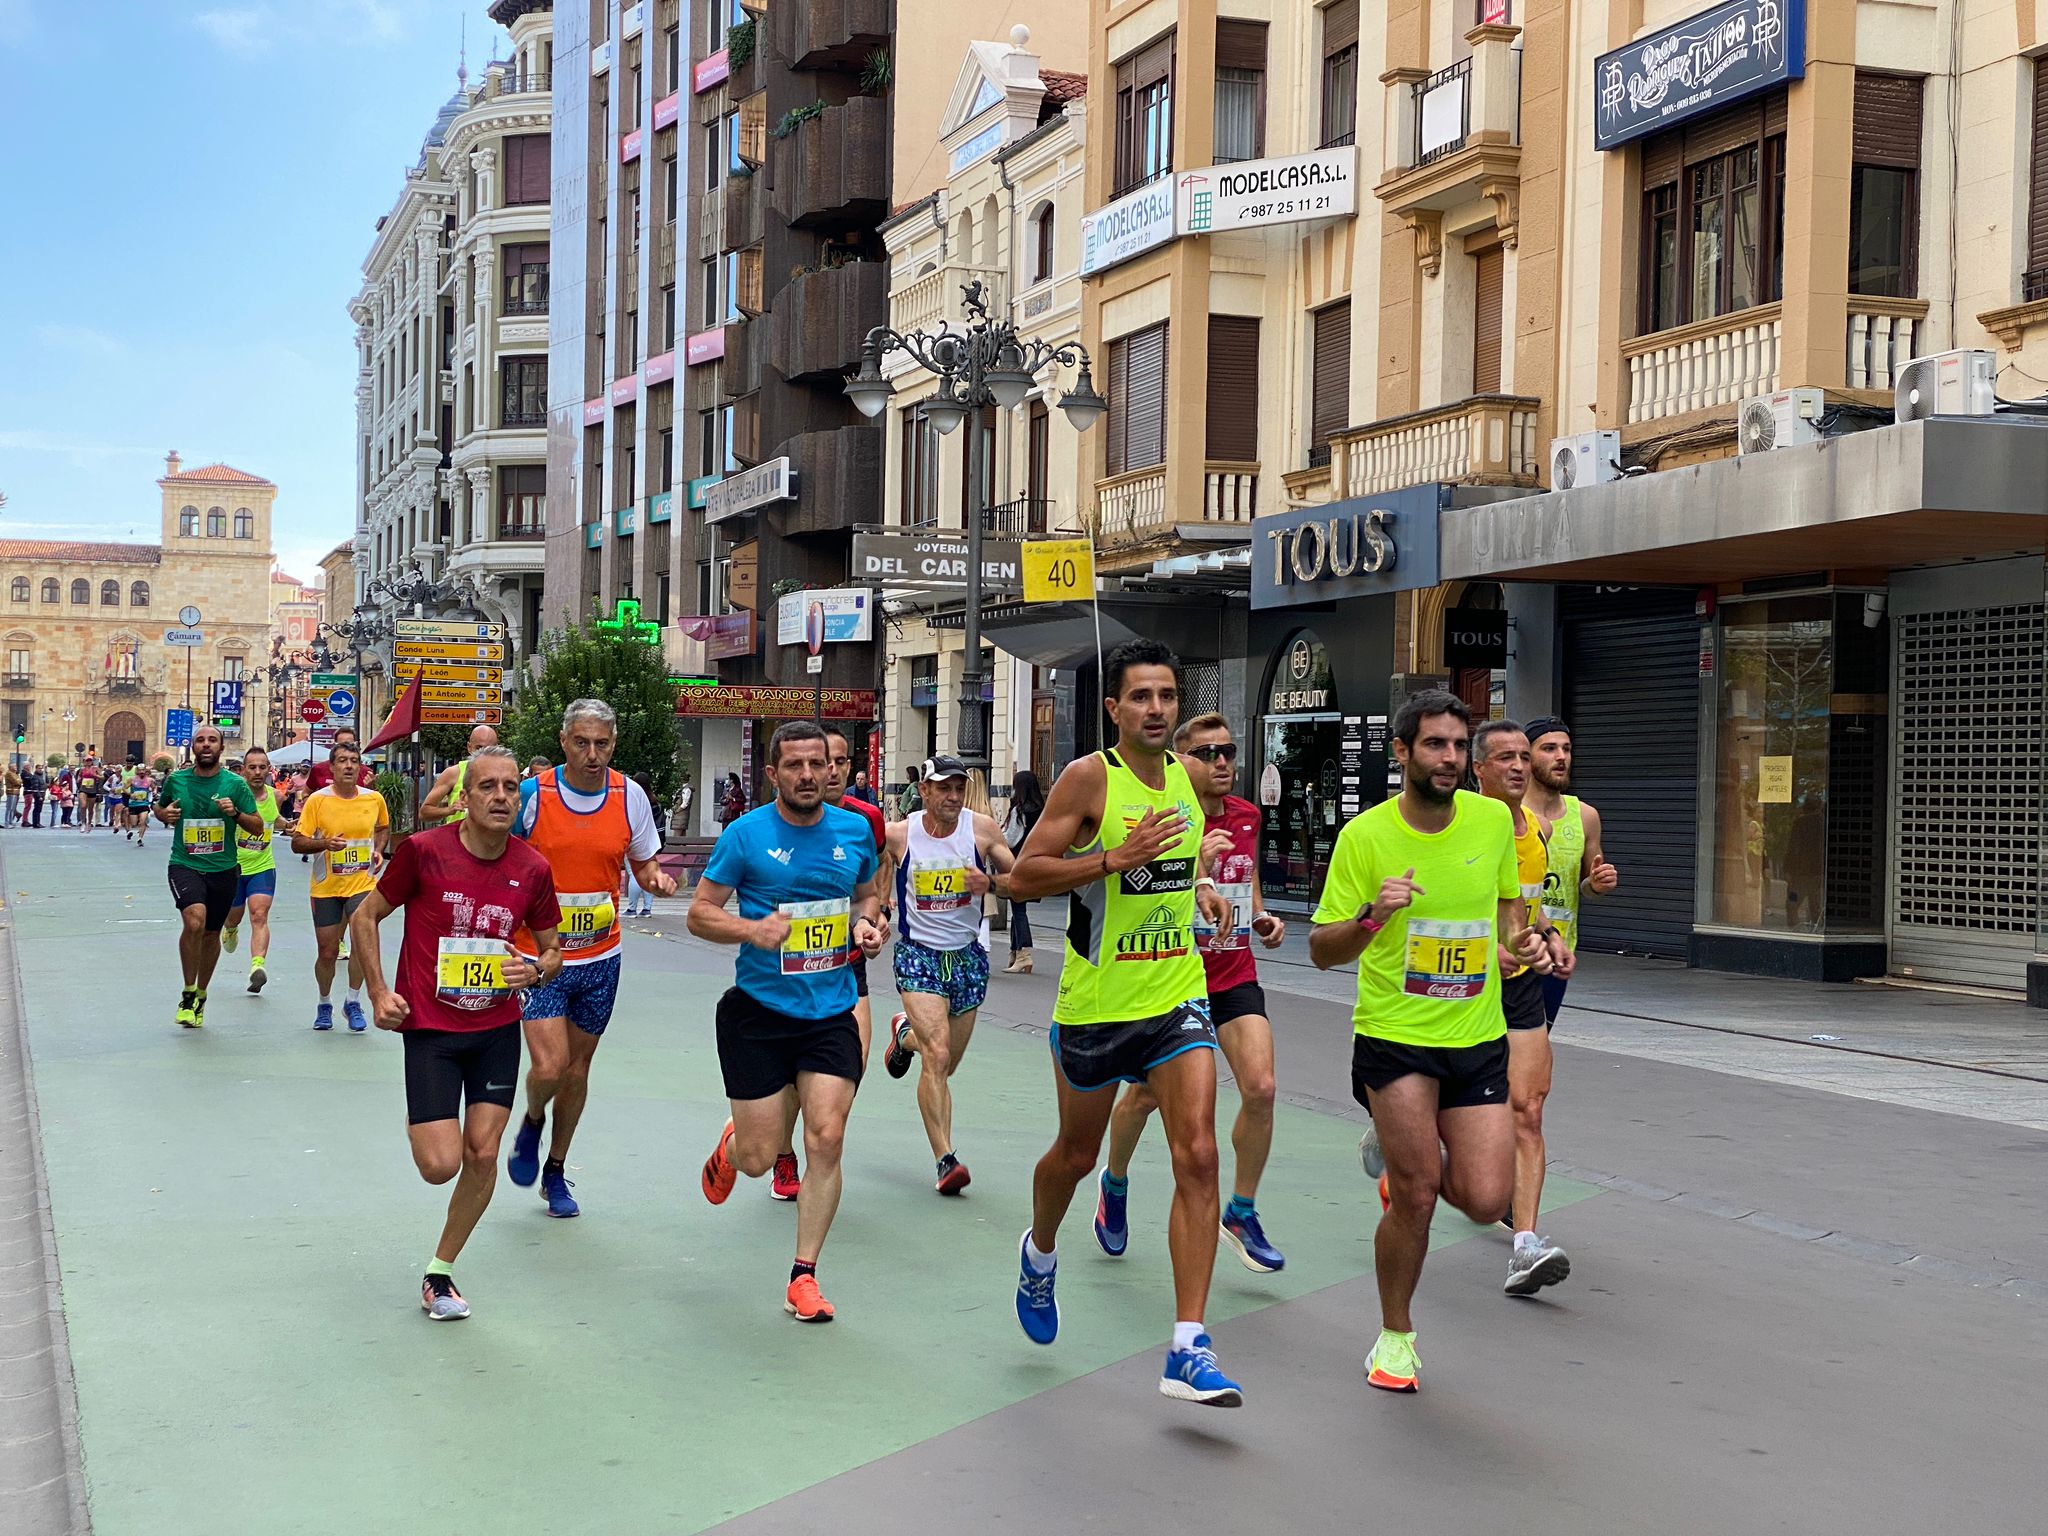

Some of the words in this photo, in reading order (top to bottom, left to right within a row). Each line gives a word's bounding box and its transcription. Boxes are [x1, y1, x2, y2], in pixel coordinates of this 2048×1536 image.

[1251, 203, 1274, 218] 987
[1277, 201, 1294, 215] 25
[1298, 198, 1311, 211] 11
[1315, 196, 1330, 209] 21
[1130, 237, 1137, 250] 25
[1144, 231, 1151, 243] 21
[914, 543, 969, 555] JOYERIA
[1268, 509, 1396, 585] TOUS
[866, 556, 908, 573] DEL
[921, 558, 1016, 579] CAREN
[1047, 559, 1076, 588] 40
[167, 631, 202, 641] Cámara
[1450, 631, 1503, 646] TOUS
[397, 645, 423, 653] Conde
[426, 645, 445, 654] Luna
[1293, 651, 1307, 668] BE
[397, 666, 413, 674] Luis
[430, 667, 449, 676] León
[912, 676, 938, 688] ESTRELLA
[216, 683, 231, 705] P
[436, 690, 466, 698] Antonio
[679, 687, 743, 698] ROYAL
[751, 689, 852, 702] TANDOORI
[1274, 692, 1287, 710] BE
[1289, 689, 1327, 708] BEAUTY
[302, 707, 324, 715] STOP
[808, 702, 830, 710] BR
[424, 711, 449, 719] Conde
[452, 711, 470, 719] Luna
[197, 830, 212, 843] 181
[344, 850, 358, 863] 119
[1161, 861, 1187, 872] GRUPO
[933, 875, 954, 893] 42
[443, 891, 464, 899] 2022
[571, 913, 594, 931] 118
[804, 923, 834, 950] 157
[1437, 947, 1467, 974] 115
[462, 962, 494, 987] 134
